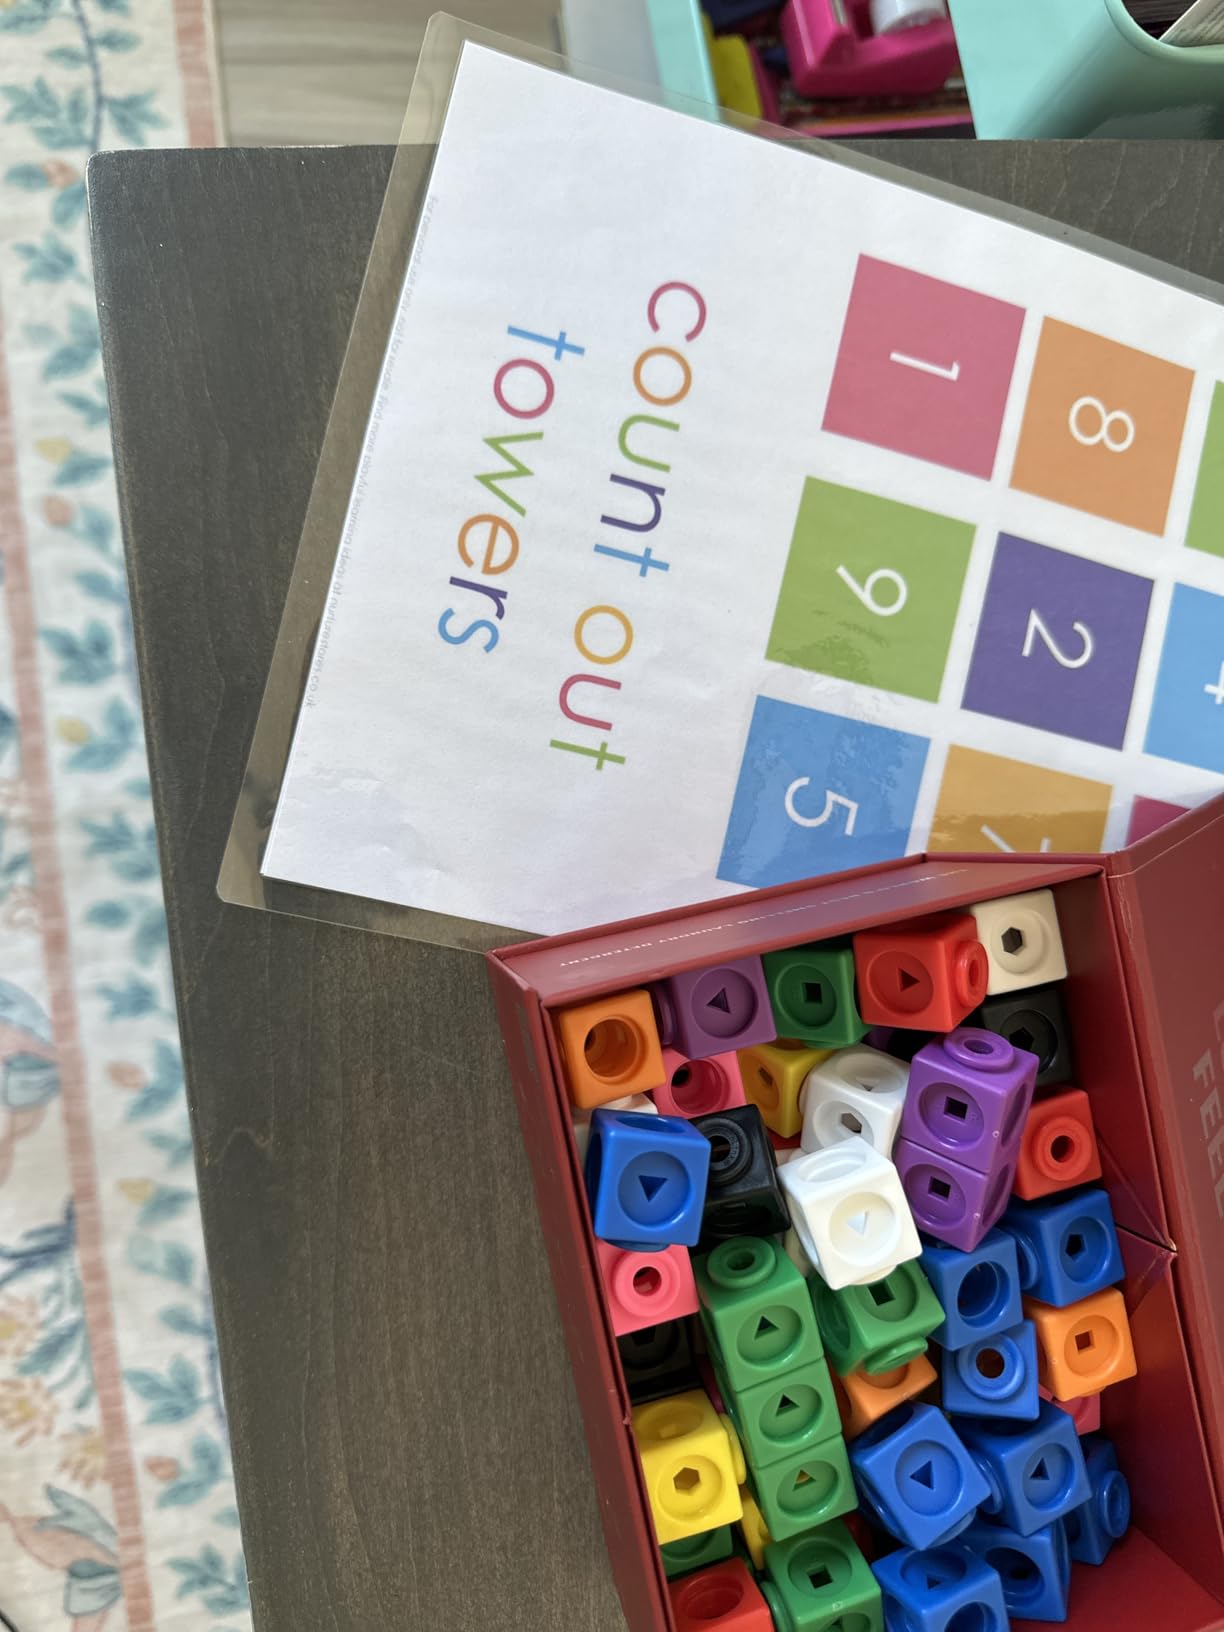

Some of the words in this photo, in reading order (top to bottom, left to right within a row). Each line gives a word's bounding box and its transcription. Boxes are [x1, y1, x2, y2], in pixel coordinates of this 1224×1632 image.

[889, 350, 960, 382] 1
[594, 281, 707, 577] count
[1068, 395, 1136, 453] 8
[437, 325, 585, 653] towers
[836, 564, 909, 617] 9
[1022, 608, 1094, 669] 2
[550, 604, 634, 771] out
[784, 776, 859, 837] 5
